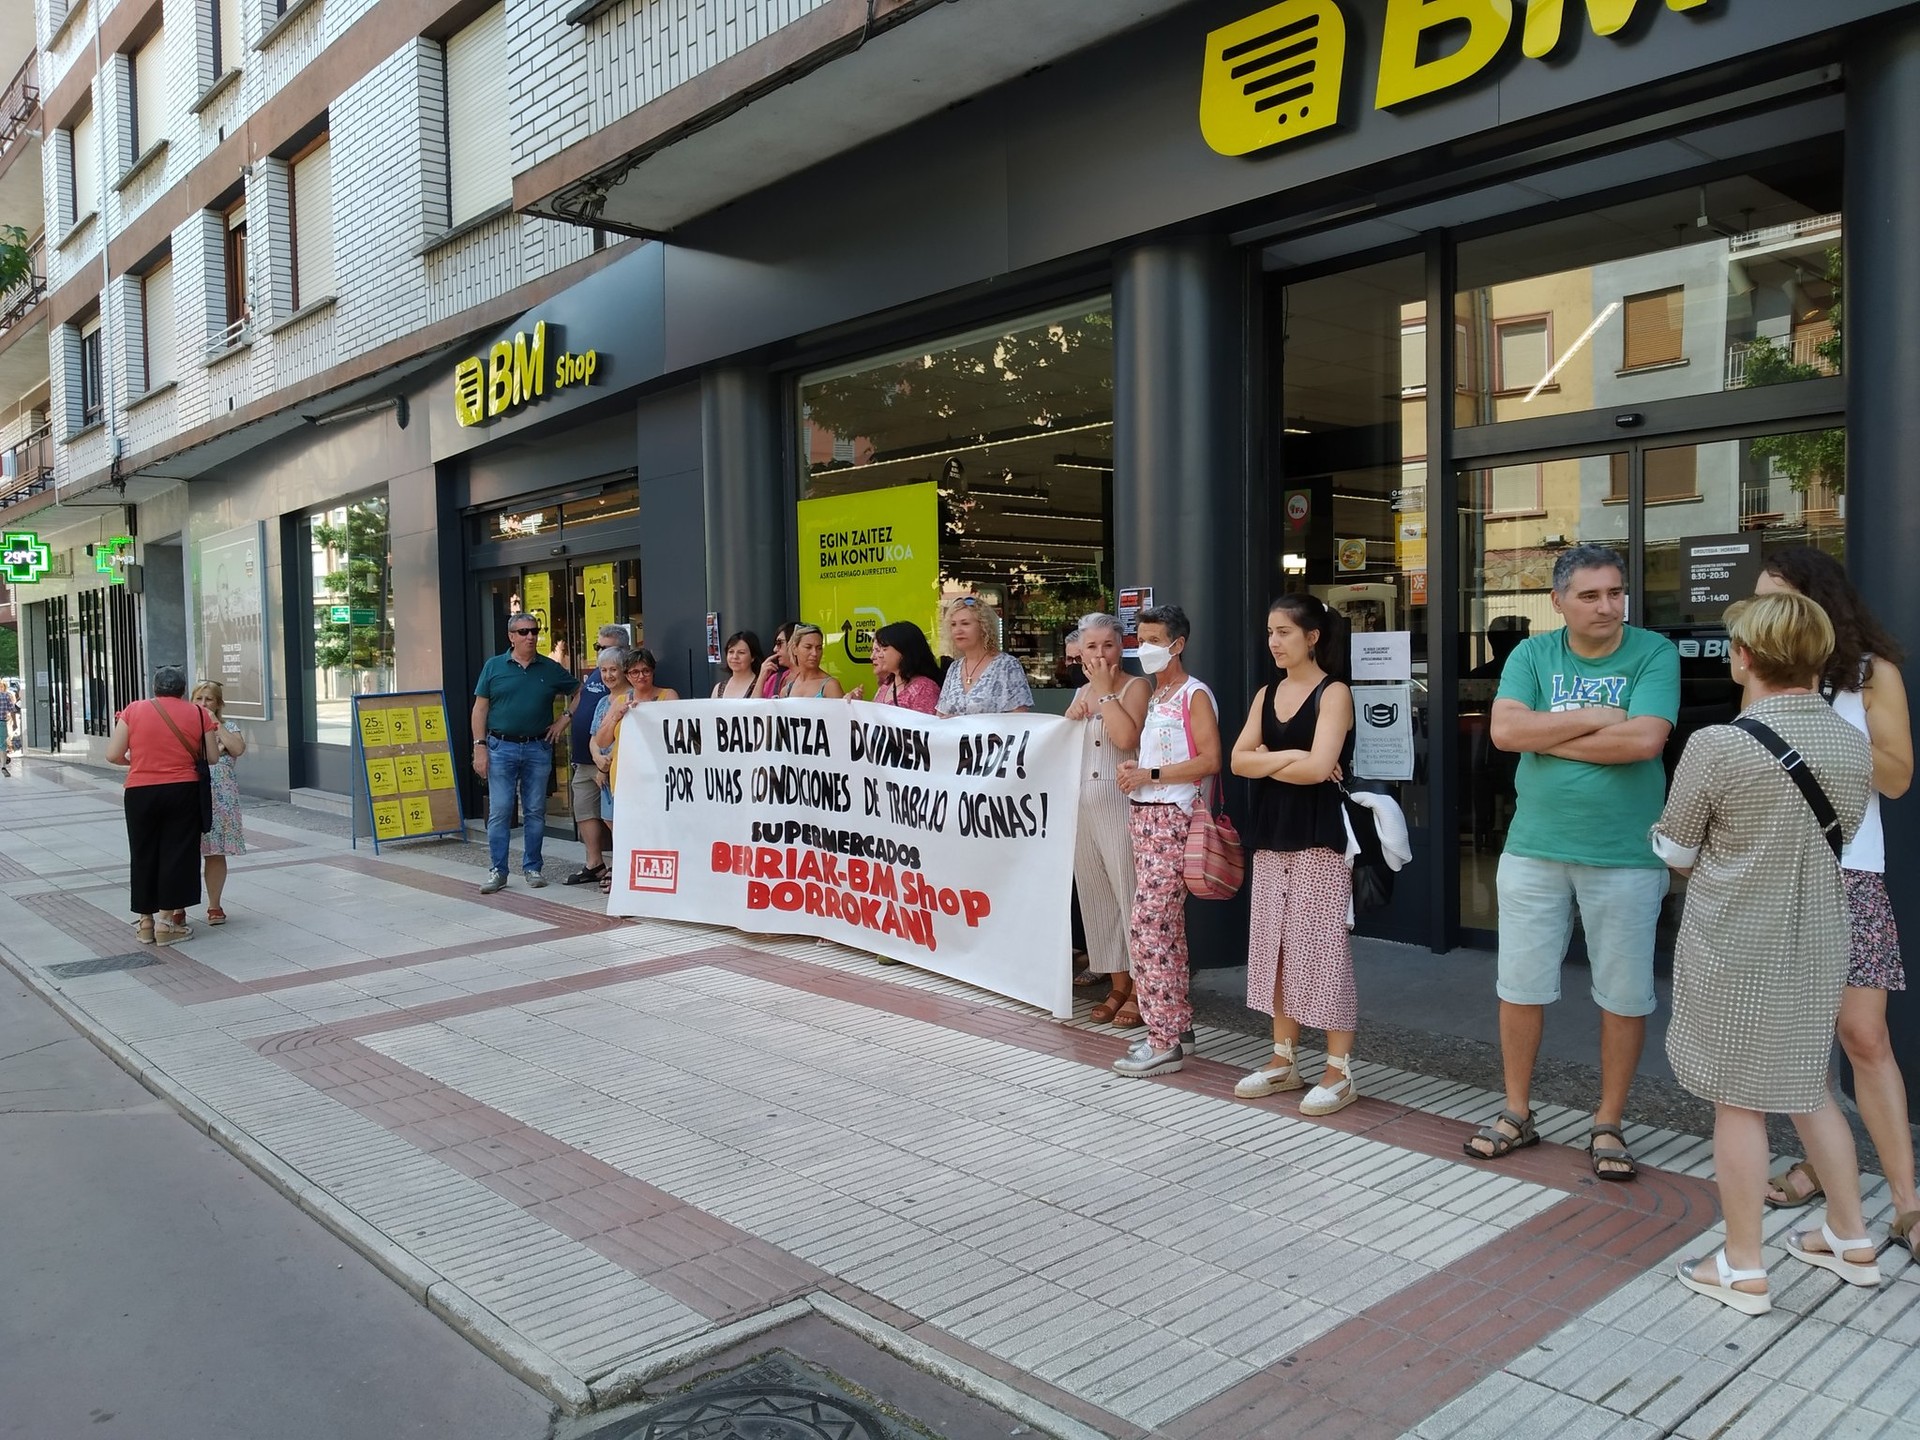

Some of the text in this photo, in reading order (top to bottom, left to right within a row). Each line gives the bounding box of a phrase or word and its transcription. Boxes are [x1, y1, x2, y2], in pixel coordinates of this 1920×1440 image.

[488, 320, 545, 417] BM
[820, 526, 893, 549] EGIN ZAITEZ
[820, 544, 914, 567] BM KONTUKOA
[820, 569, 837, 579] ASKOZ
[837, 567, 861, 578] GEHIAGO
[1691, 571, 1730, 580] 8:30-20:30
[1691, 594, 1730, 602] 8:30-14:00
[855, 619, 876, 628] cuenta
[1551, 674, 1627, 706] LAZY
[394, 721, 402, 732] 9
[425, 719, 433, 730] 8
[663, 717, 702, 756] LAN
[715, 715, 831, 758] BALDINTZA
[850, 719, 931, 772] DUINEN
[402, 766, 413, 776] 13
[431, 764, 440, 775] 5
[374, 772, 382, 783] 9
[665, 766, 694, 811] ¡POR
[705, 767, 743, 804] UNAS
[751, 765, 851, 812] CONDICIONES
[864, 777, 881, 817] DE
[886, 781, 948, 833] TRABAJO
[378, 815, 392, 825] 26
[410, 810, 420, 820] 12
[752, 820, 921, 869] SUPERMERCADOS
[638, 857, 673, 879] LAB
[900, 871, 991, 928] Shop
[747, 880, 937, 952] BORROKAN!
